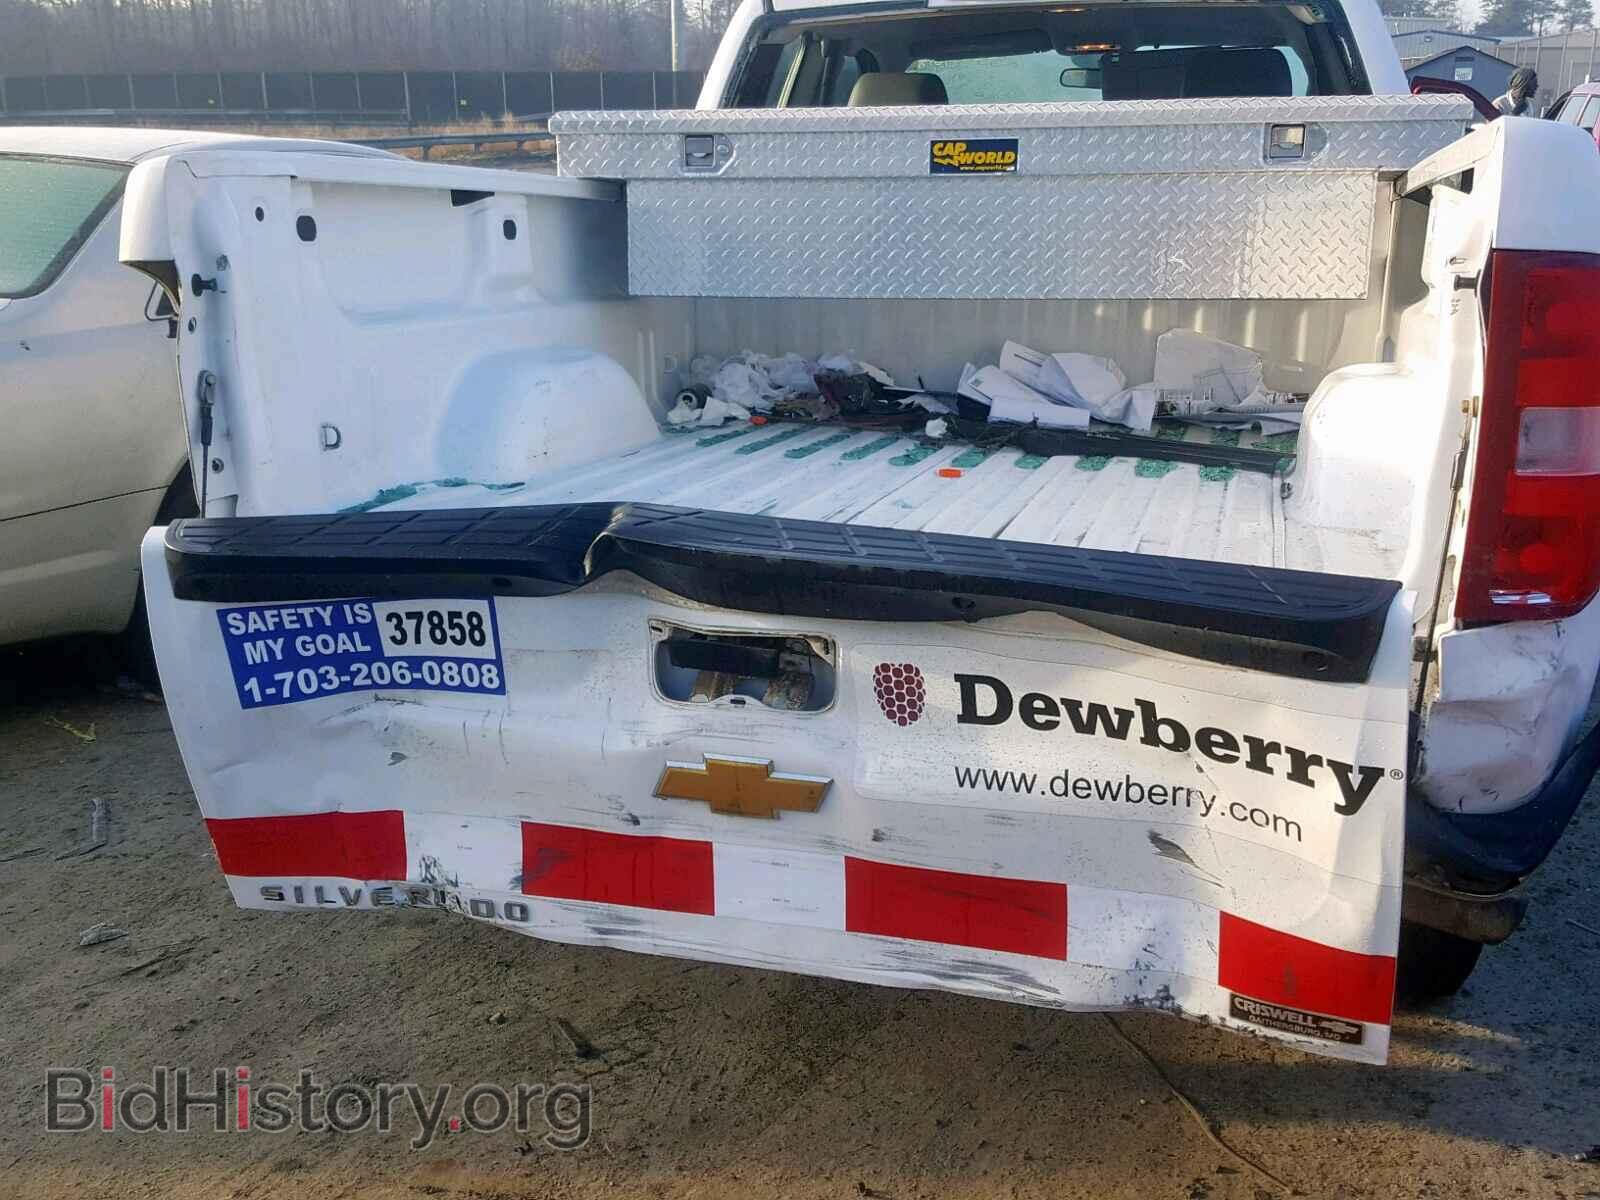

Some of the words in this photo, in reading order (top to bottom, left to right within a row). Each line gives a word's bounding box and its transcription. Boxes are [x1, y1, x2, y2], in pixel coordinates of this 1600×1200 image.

[932, 142, 967, 156] CAP
[959, 151, 1016, 164] WORLD
[227, 605, 335, 636] SAFETY
[344, 603, 373, 625] IS
[385, 610, 488, 648] 37858
[243, 638, 285, 666] MY
[295, 632, 372, 658] GOAL
[243, 660, 501, 702] 1-703-206-0808
[954, 766, 1304, 842] www.dewberry.com
[1233, 997, 1317, 1027] CRISWELL
